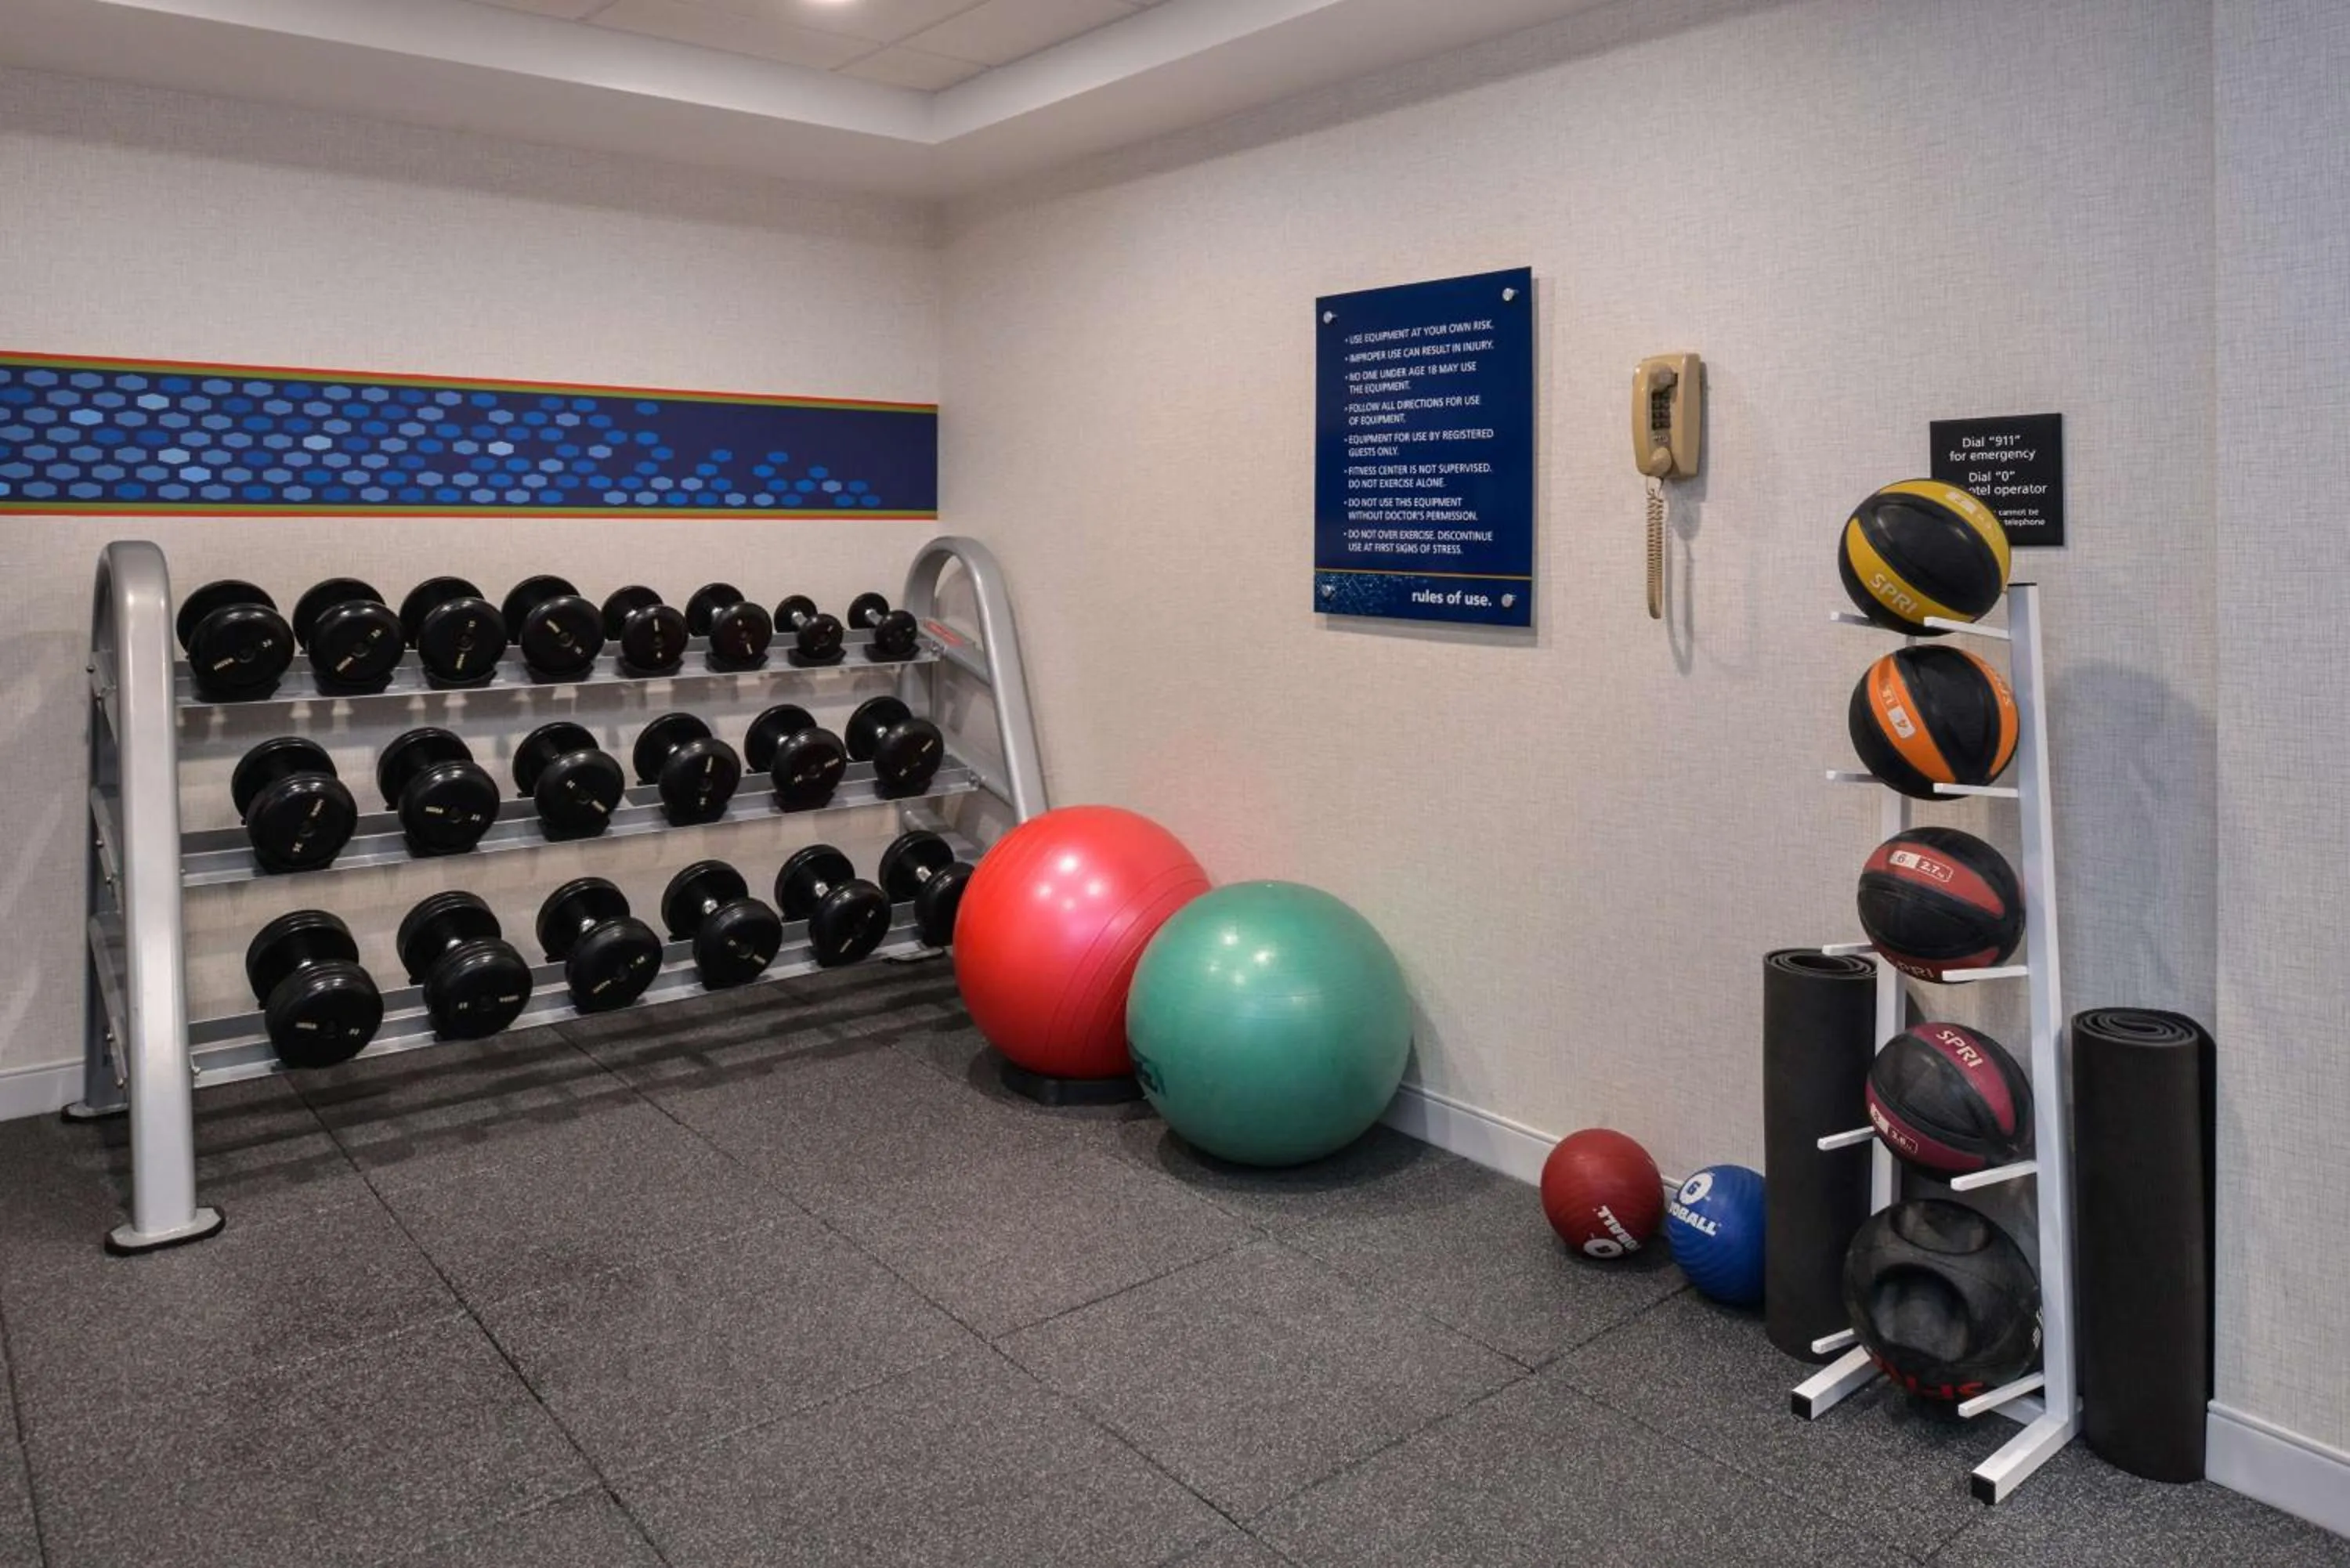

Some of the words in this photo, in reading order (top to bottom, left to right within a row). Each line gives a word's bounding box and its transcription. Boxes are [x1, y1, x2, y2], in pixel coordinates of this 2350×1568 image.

[1350, 334, 1363, 344] USE
[1365, 329, 1409, 342] EQUIPMENT
[1412, 327, 1421, 337] AT
[1423, 325, 1446, 335] YOUR
[1448, 322, 1471, 332] OWN
[1473, 320, 1495, 330] RISK.
[1350, 351, 1385, 363] IMPROPER
[1388, 349, 1401, 358] USE
[1404, 347, 1420, 357] CAN
[1422, 345, 1450, 355] RESULT
[1452, 343, 1461, 352] IN
[1463, 340, 1494, 351] INJURY.
[1350, 372, 1360, 381] NO
[1363, 370, 1378, 379] ONE
[1380, 367, 1407, 378] UNDER
[1408, 367, 1425, 375] AGE
[1428, 366, 1437, 374] 18
[1439, 363, 1459, 373] MAY
[1461, 362, 1477, 371] USE
[1350, 385, 1363, 394] THE
[1365, 381, 1410, 392] EQUIPMENT.
[1349, 403, 1379, 413] FOLLOW
[1382, 402, 1395, 410] ALL
[1397, 398, 1444, 410] DIRECTIONS
[1446, 396, 1462, 406] FOR
[1464, 396, 1480, 405] USE
[1349, 417, 1359, 425] OF
[1361, 414, 1405, 425] EQUIPMENT.
[1349, 434, 1392, 444] EQUIPMENT
[1394, 432, 1410, 442] FOR
[1412, 432, 1426, 441] USE
[1429, 432, 1441, 440] BY
[1443, 429, 1494, 440] REGISTERED
[1962, 437, 1984, 448] Dial
[1989, 435, 2021, 446] "911"
[1349, 448, 1376, 457] GUESTS
[1377, 447, 1399, 456] ONLY.
[1950, 452, 1967, 461] for
[1970, 450, 2035, 462] emergency
[1349, 466, 1376, 475] FITNESS
[1379, 465, 1408, 475] CENTER
[1410, 464, 1416, 474] IS
[1419, 464, 1436, 474] NOT
[1439, 464, 1491, 473] SUPERVISED.
[1969, 472, 1991, 482] Dial
[1996, 471, 2016, 480] "0"
[1348, 480, 1360, 489] DO
[1362, 479, 1377, 488] NOT
[1380, 479, 1413, 488] EXERCISE
[1416, 478, 1448, 487] ALONE.
[1994, 485, 2048, 497] operator
[1348, 498, 1360, 507] DO
[1362, 498, 1377, 507] NOT
[1379, 498, 1393, 507] USE
[1396, 497, 1412, 507] THIS
[1414, 498, 1462, 508] EQUIPMENT
[1348, 511, 1383, 520] WITHOUT
[1385, 511, 1424, 520] DOCTOR'S
[1426, 511, 1478, 521] PERMISSION.
[1348, 529, 1359, 538] DO
[1361, 529, 1376, 539] NOT
[1378, 529, 1397, 539] OVER
[1438, 531, 1492, 540] DISCONTINUE
[1376, 544, 1394, 552] FIRST
[1396, 544, 1418, 552] SIGNS
[1420, 544, 1430, 553] OF
[1433, 544, 1463, 554] STRESS.
[1412, 590, 1443, 604] rules
[1448, 591, 1462, 604] of
[1465, 595, 1491, 606] use.
[1869, 573, 1918, 614] SPRI
[1936, 1030, 1983, 1067] SPRI
